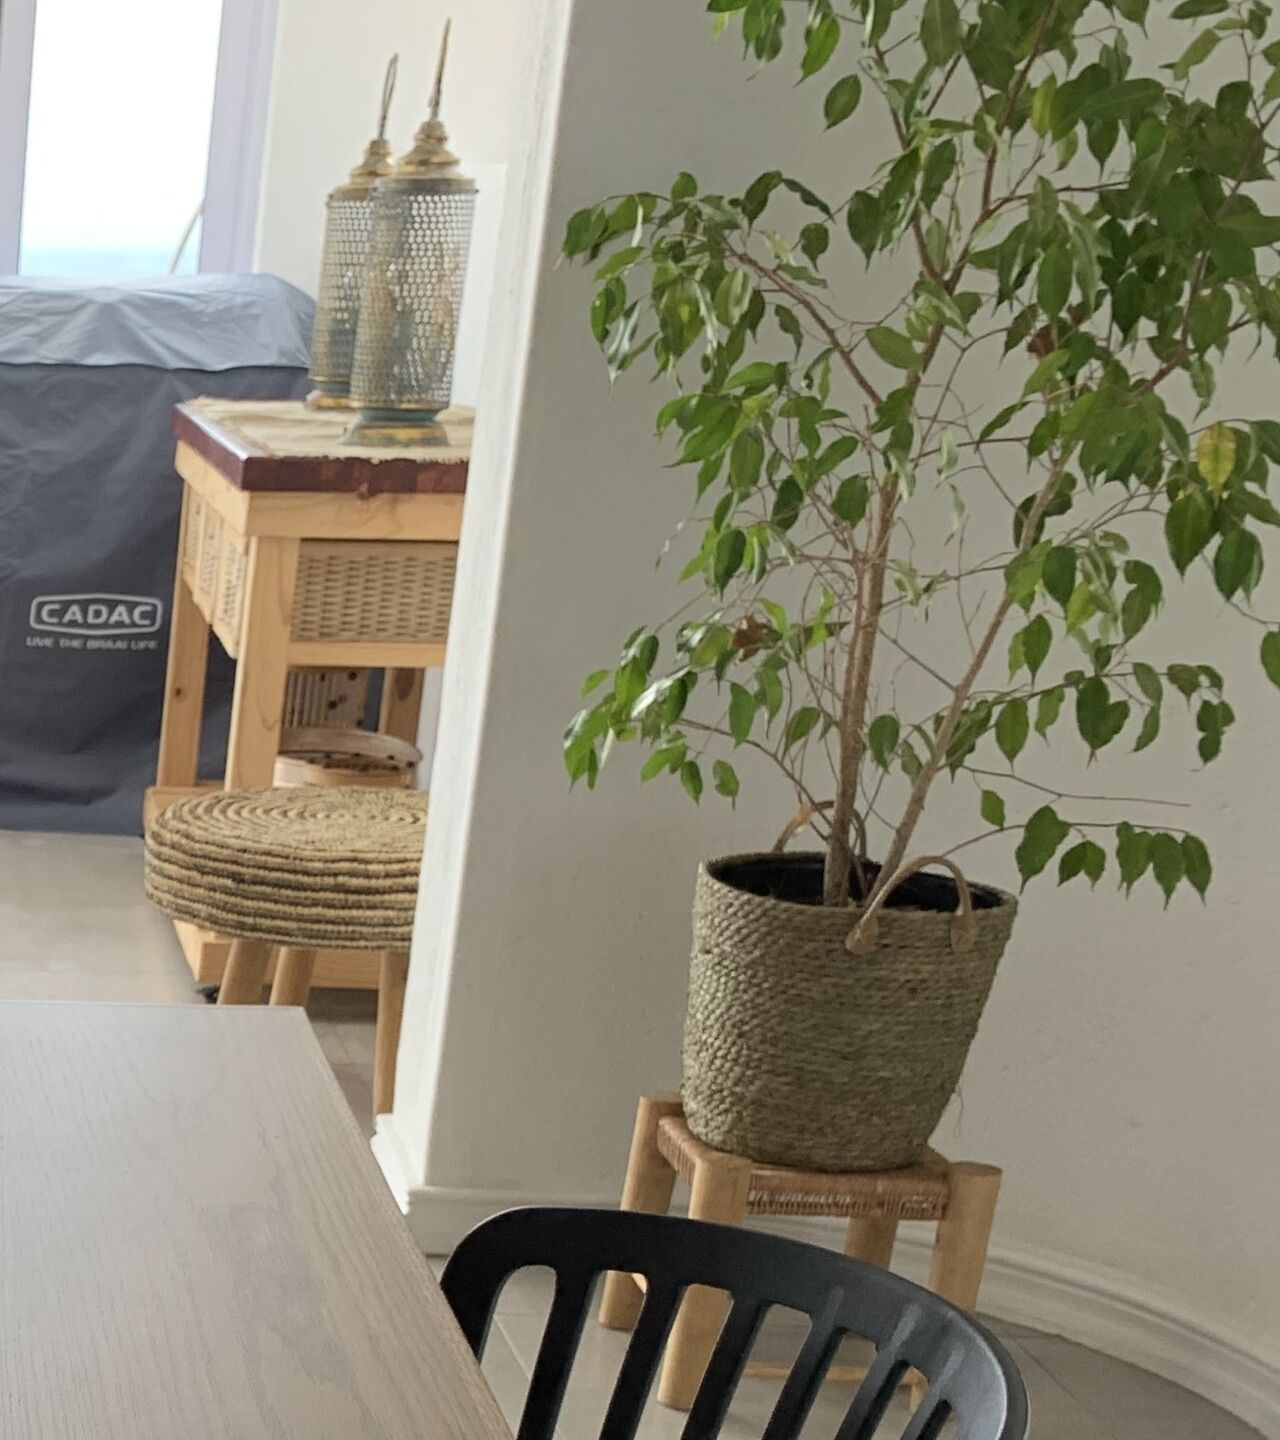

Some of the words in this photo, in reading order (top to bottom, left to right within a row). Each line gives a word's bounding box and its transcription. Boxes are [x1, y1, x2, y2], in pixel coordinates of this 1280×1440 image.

[41, 604, 153, 625] CADAC
[26, 637, 54, 648] LIVE
[59, 638, 83, 649] THE
[131, 640, 159, 650] LIFE
